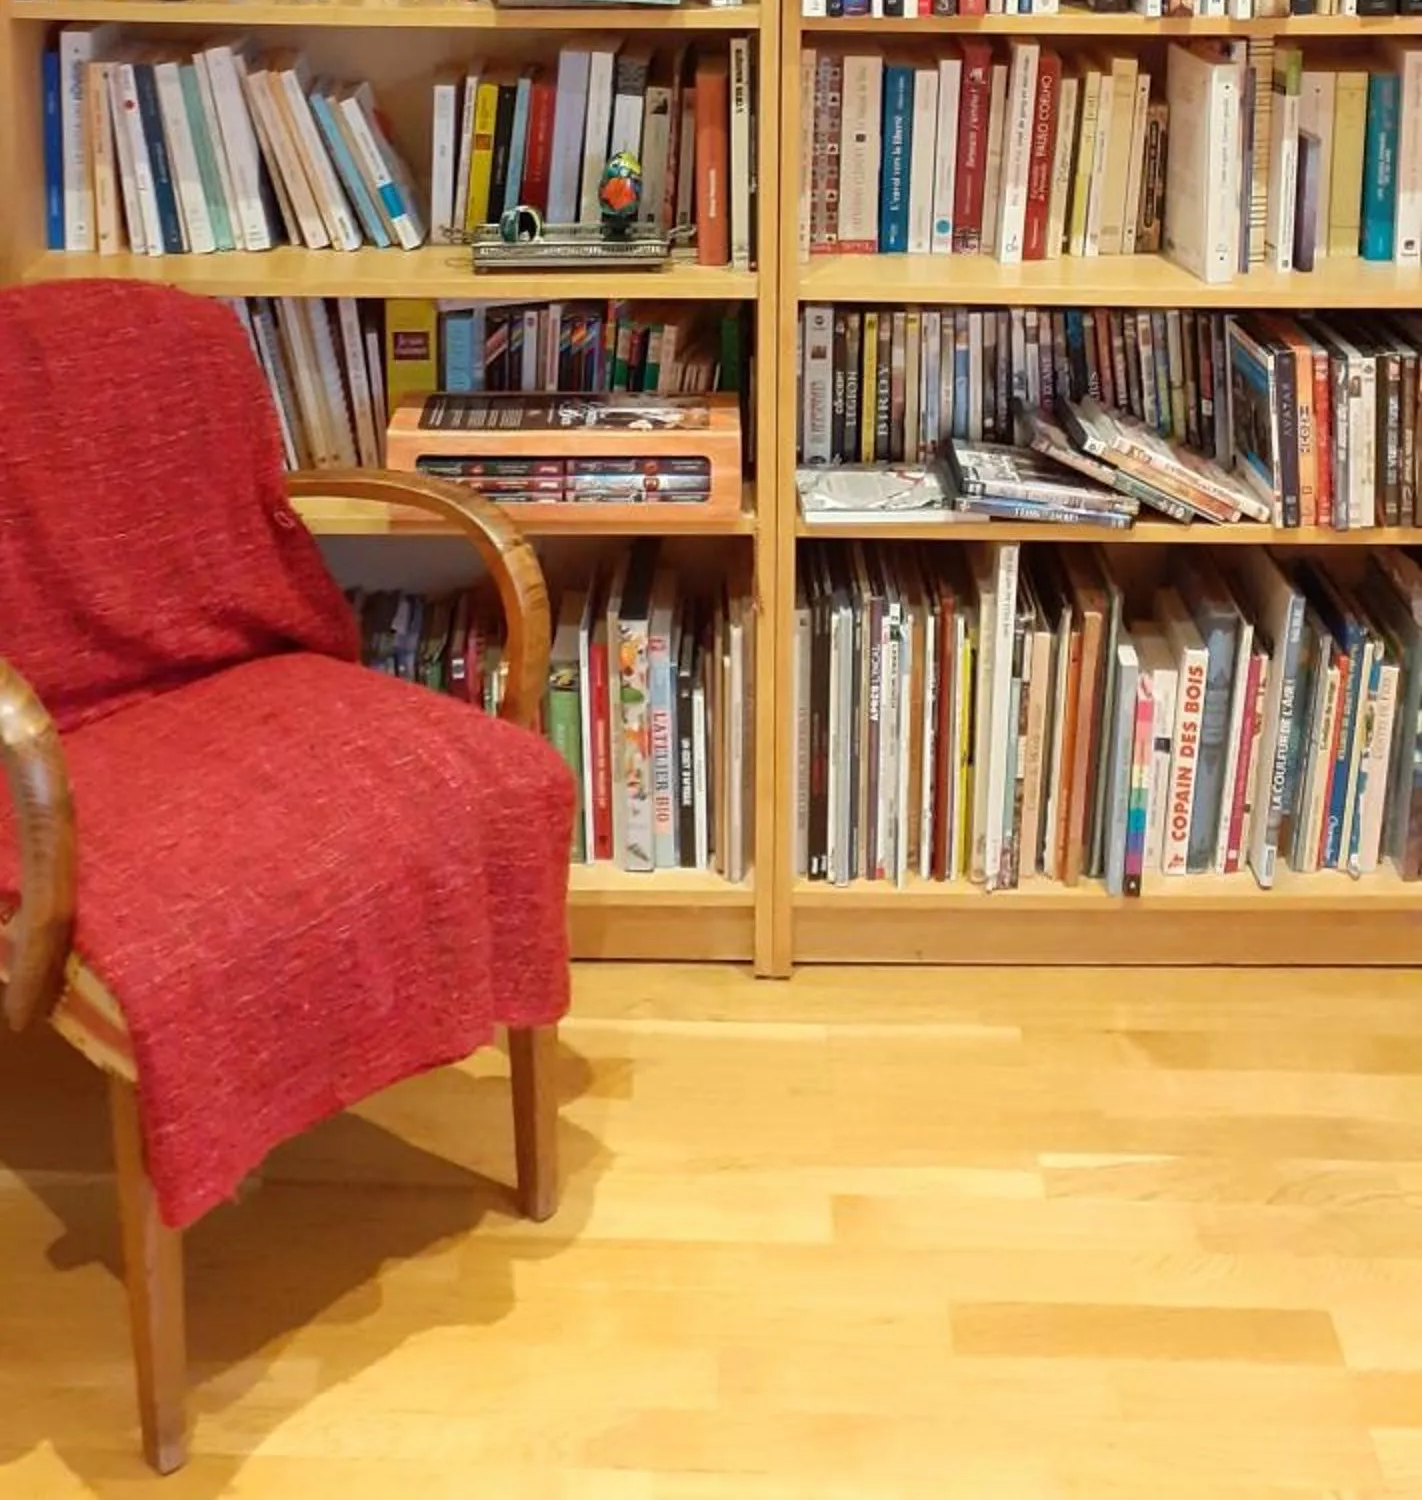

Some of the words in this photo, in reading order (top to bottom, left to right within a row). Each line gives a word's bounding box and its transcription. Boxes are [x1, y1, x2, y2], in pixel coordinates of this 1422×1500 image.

[1036, 74, 1052, 120] COELHO
[1034, 123, 1049, 157] PAULO
[877, 363, 889, 436] BIRDY
[1282, 382, 1293, 438] AVATAR
[1179, 720, 1197, 757] DES
[1273, 734, 1292, 793] COULEUR
[652, 795, 670, 823] BIO
[1171, 765, 1193, 843] COPAIN
[1271, 794, 1284, 811] LA
